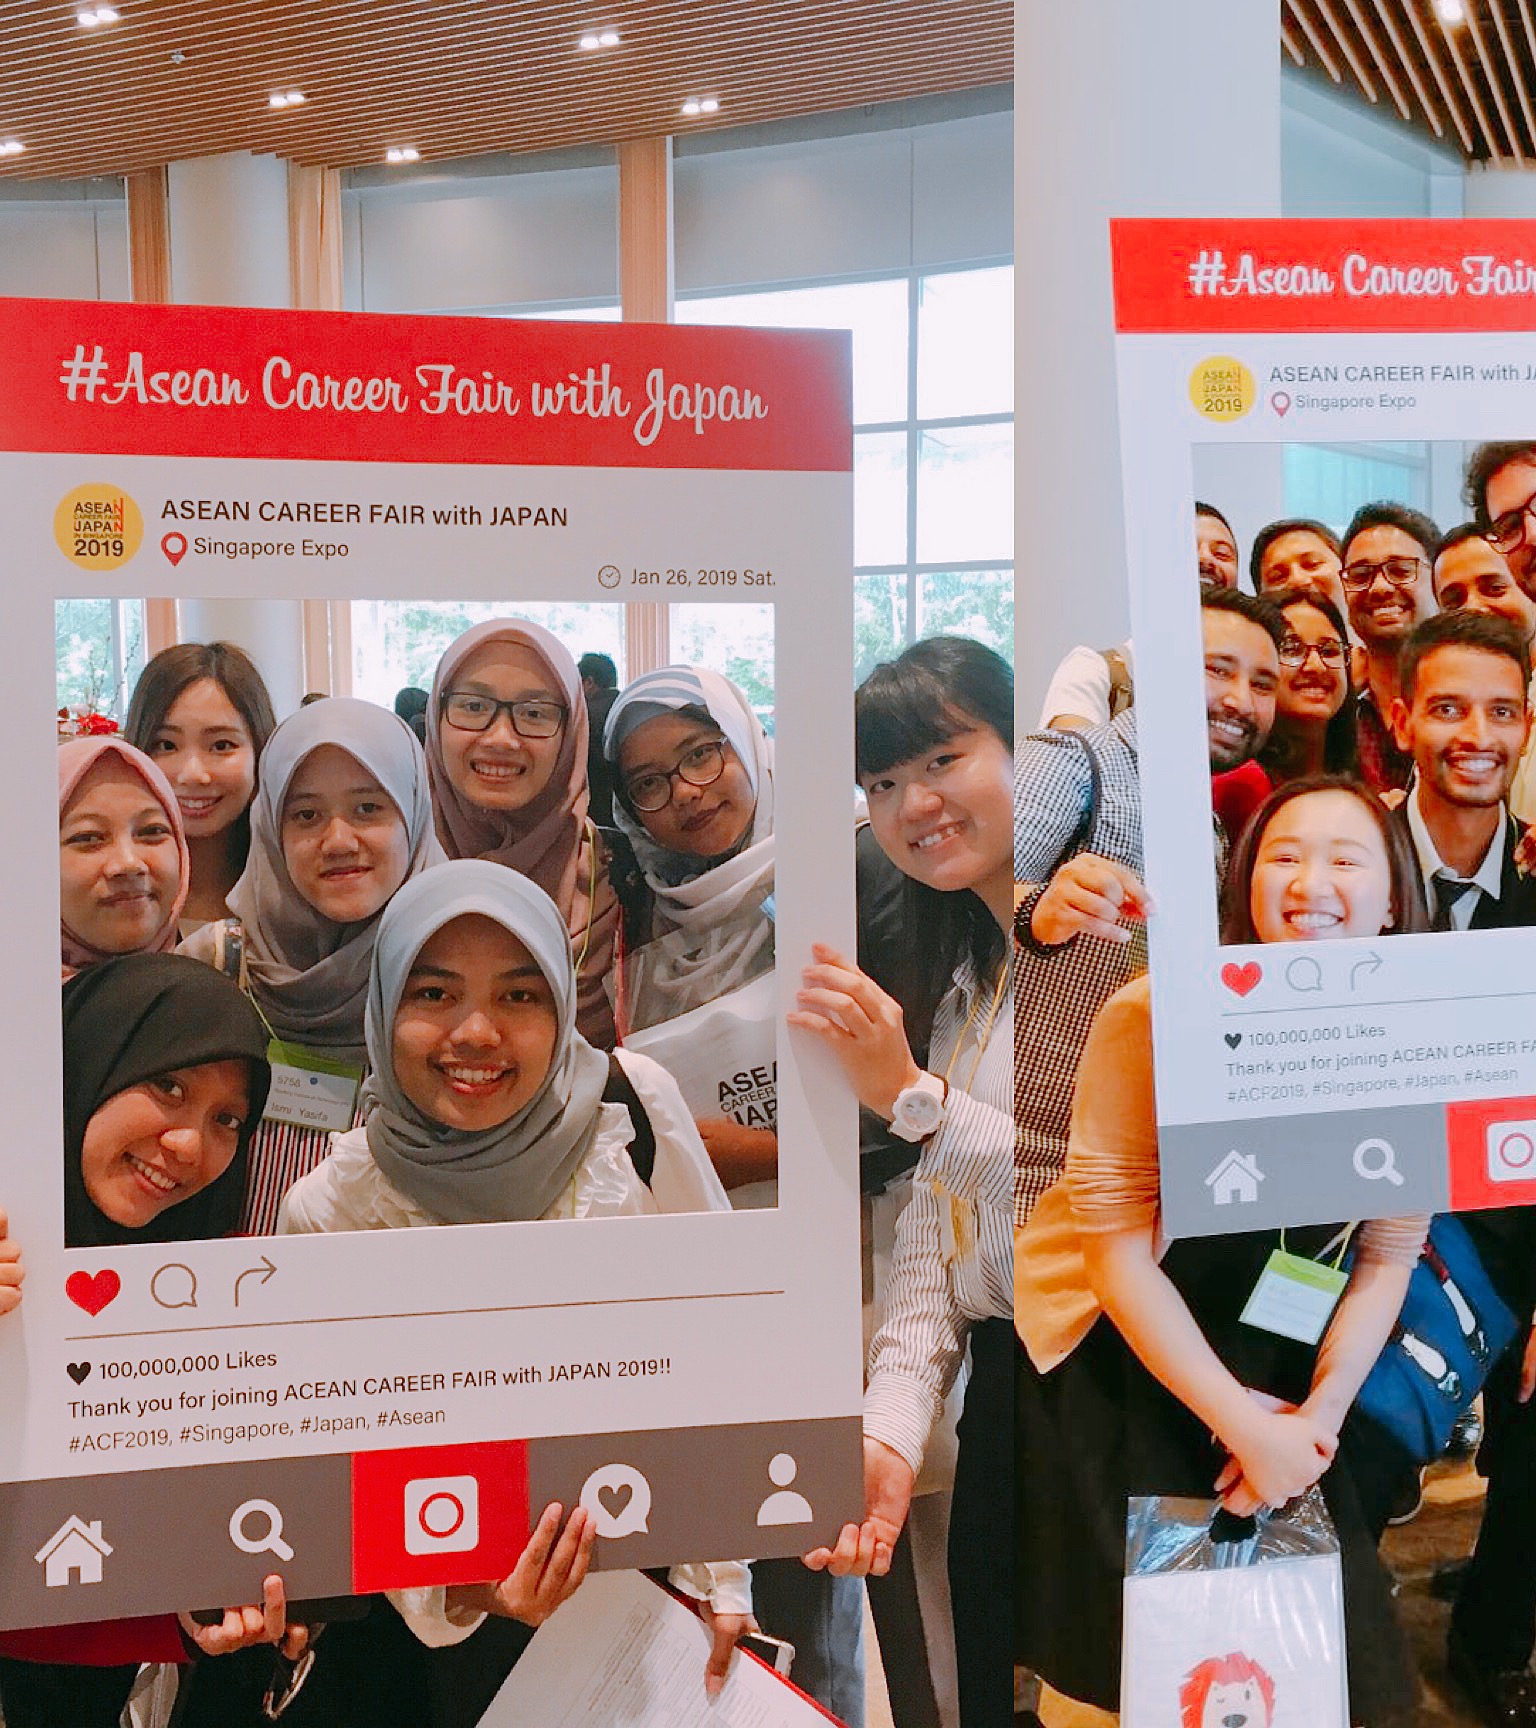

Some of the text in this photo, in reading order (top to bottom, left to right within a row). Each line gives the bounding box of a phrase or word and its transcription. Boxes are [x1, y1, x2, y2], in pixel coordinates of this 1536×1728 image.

[1342, 253, 1460, 297] Career
[1269, 366, 1338, 383] ASEAN
[1344, 366, 1425, 382] CAREER
[1430, 365, 1475, 381] FAIR
[1479, 363, 1519, 381] with
[59, 343, 769, 447] #Asean Career Fair with Japan
[1204, 398, 1242, 412] 2019
[1295, 393, 1417, 413] Singapore Expo
[74, 498, 124, 514] ASEAN
[160, 499, 567, 527] ASEAN CAREER FAIR with JAPAN
[73, 520, 124, 532] JAPAN
[74, 539, 124, 557] 2019
[193, 537, 349, 561] Singapore Expo
[631, 568, 776, 587] Jan 26, 2019 Sat.
[1248, 1023, 1386, 1047] 100,000,000 Likes
[1224, 1059, 1276, 1076] Thank
[1279, 1060, 1308, 1076] you
[1311, 1055, 1333, 1070] for
[1334, 1052, 1389, 1071] joining
[1391, 1047, 1449, 1063] ACEAN
[1453, 1040, 1517, 1059] CAREER
[1312, 1079, 1401, 1097] #Singapore,
[99, 1350, 277, 1380] 100,000,000 Likes
[67, 1357, 671, 1419] Thank you for joining ACEAN CAREER FAIR with JAPAN 2019!!
[69, 1409, 445, 1453] #ACF2019, #Singapore, #Japan, #Asean
